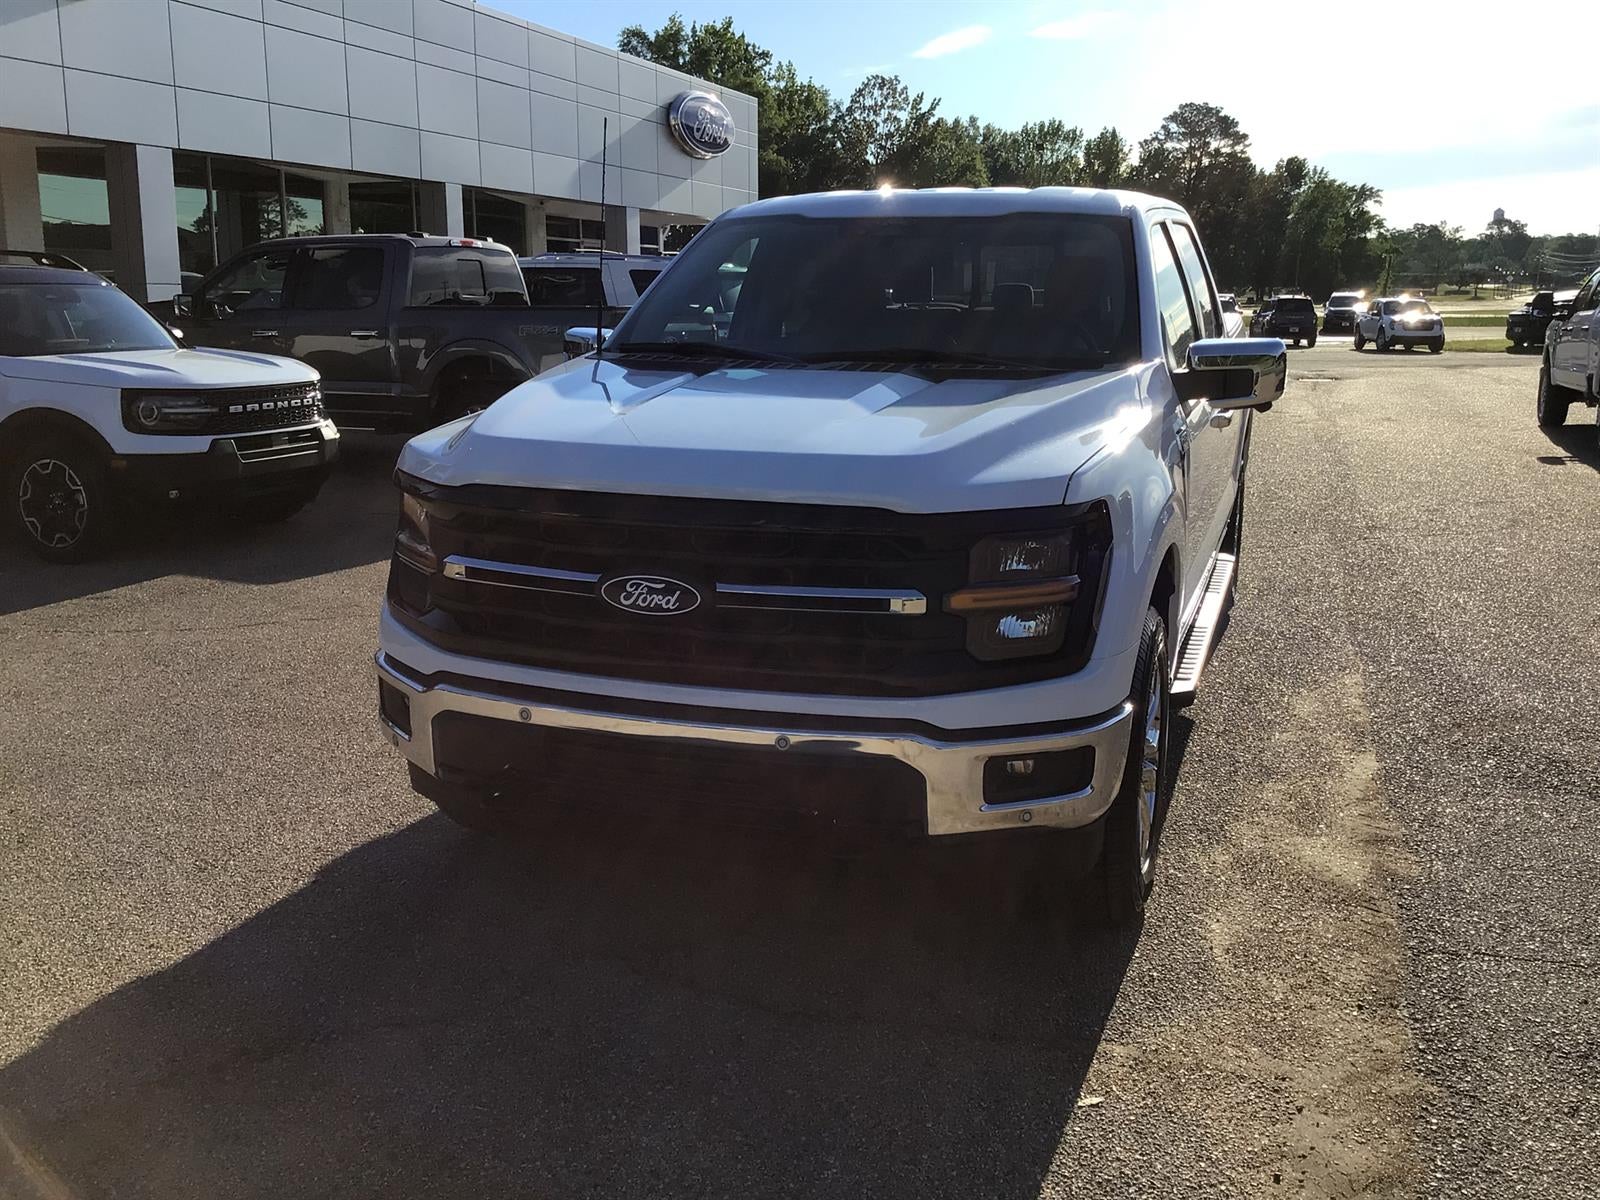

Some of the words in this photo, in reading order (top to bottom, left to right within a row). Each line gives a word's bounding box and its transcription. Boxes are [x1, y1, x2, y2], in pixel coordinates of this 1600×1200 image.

[694, 106, 726, 145] Ford
[229, 398, 313, 413] BRONCO
[620, 580, 681, 610] Ford
